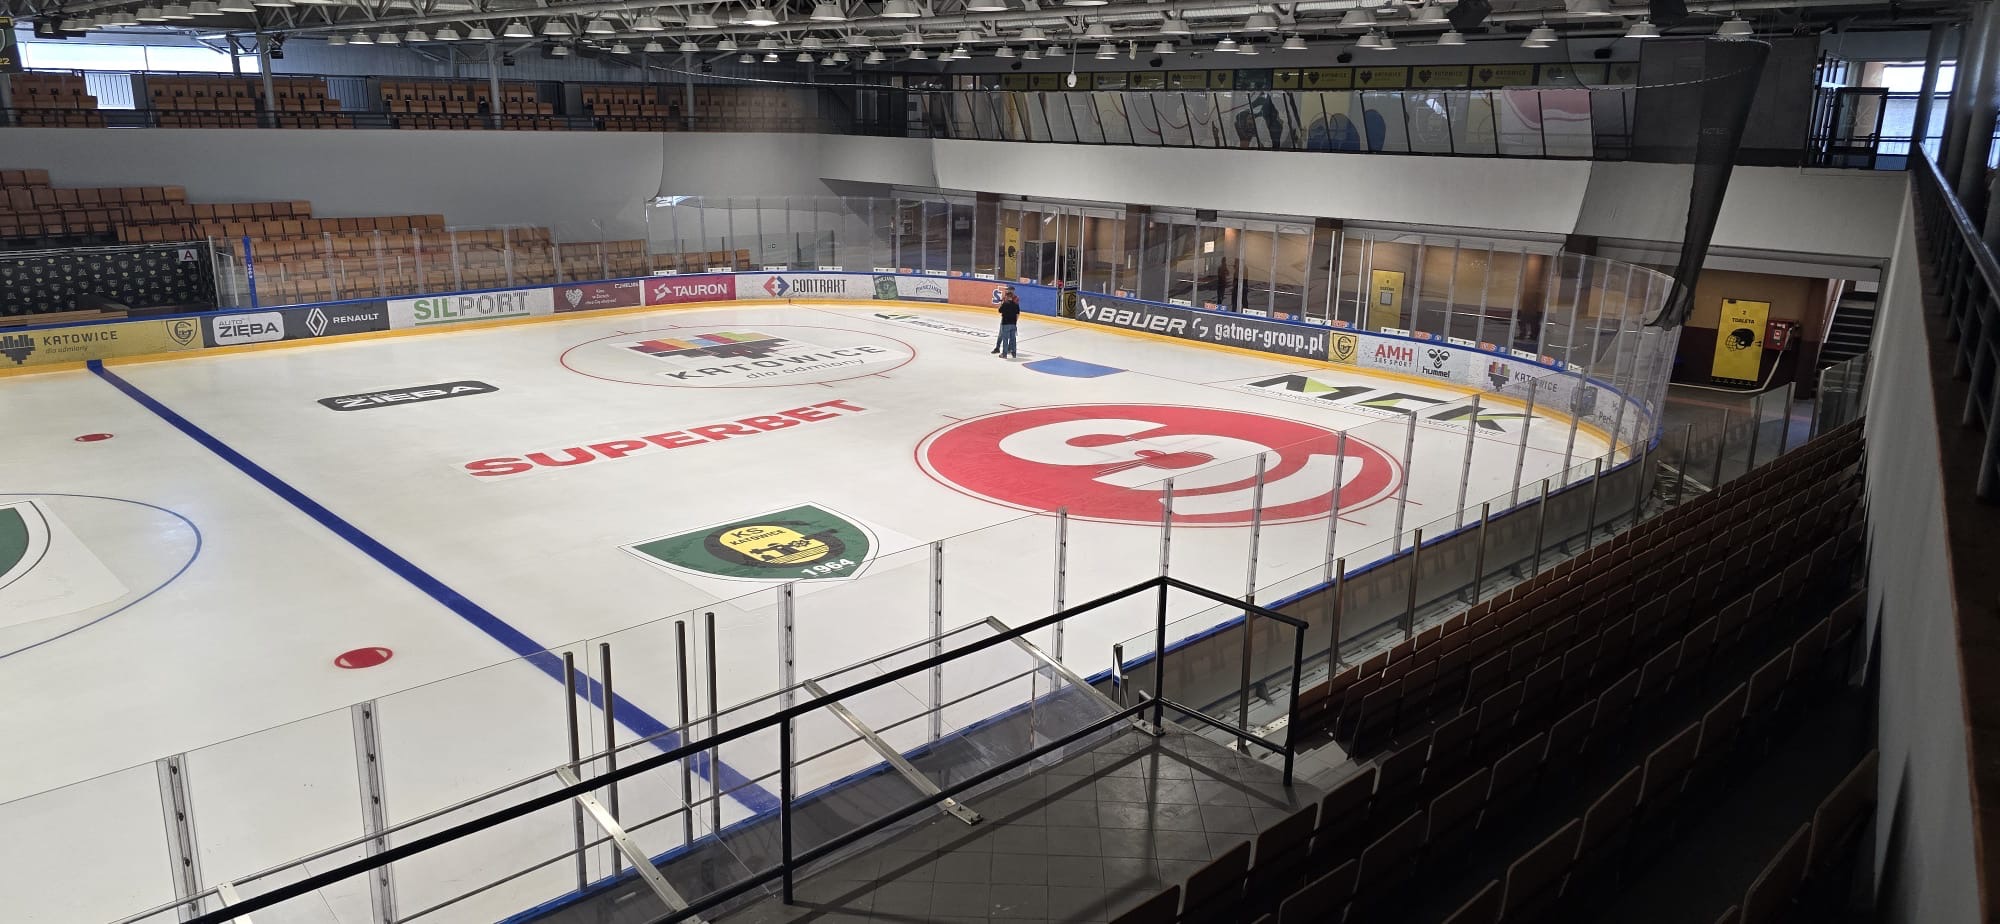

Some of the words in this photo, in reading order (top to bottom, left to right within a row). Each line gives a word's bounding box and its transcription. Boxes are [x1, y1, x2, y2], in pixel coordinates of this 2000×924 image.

[184, 250, 194, 260] A
[672, 283, 728, 297] TAURON
[792, 278, 847, 293] CONTRAKT
[413, 291, 530, 320] SILPORT
[332, 312, 379, 324] RENAULT
[1097, 307, 1187, 335] BAUER
[43, 330, 118, 346] KATOWICE
[218, 321, 279, 338] ZIĘBA
[1214, 323, 1324, 355] gatner-group.pl
[1375, 343, 1413, 361] AMH
[665, 346, 888, 380] KATOWICE
[746, 369, 778, 380] dla
[785, 358, 865, 375] odmiany
[1422, 366, 1451, 378] hummel
[335, 385, 486, 408] ZIĘBA
[1247, 374, 1542, 433] MCK
[464, 399, 867, 477] SUPERBET
[729, 529, 786, 546] KATOWICE
[730, 527, 764, 538] KS
[801, 558, 857, 577] 1964
